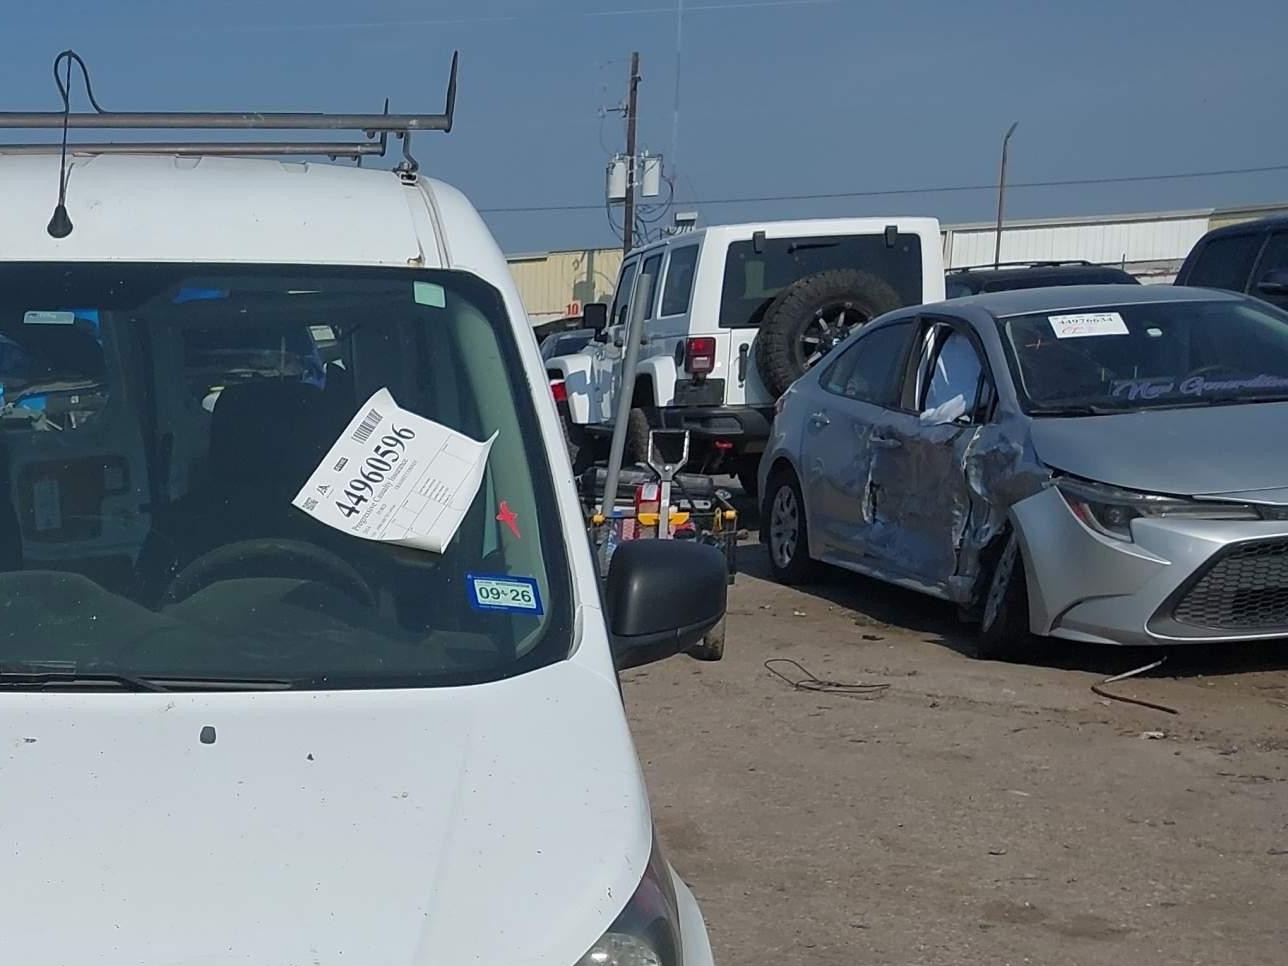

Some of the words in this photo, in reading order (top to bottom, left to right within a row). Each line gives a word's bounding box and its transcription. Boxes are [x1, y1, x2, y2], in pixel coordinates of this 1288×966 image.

[566, 303, 579, 315] 10
[335, 423, 416, 518] 44960596
[479, 587, 501, 600] 09
[509, 589, 532, 603] 26
